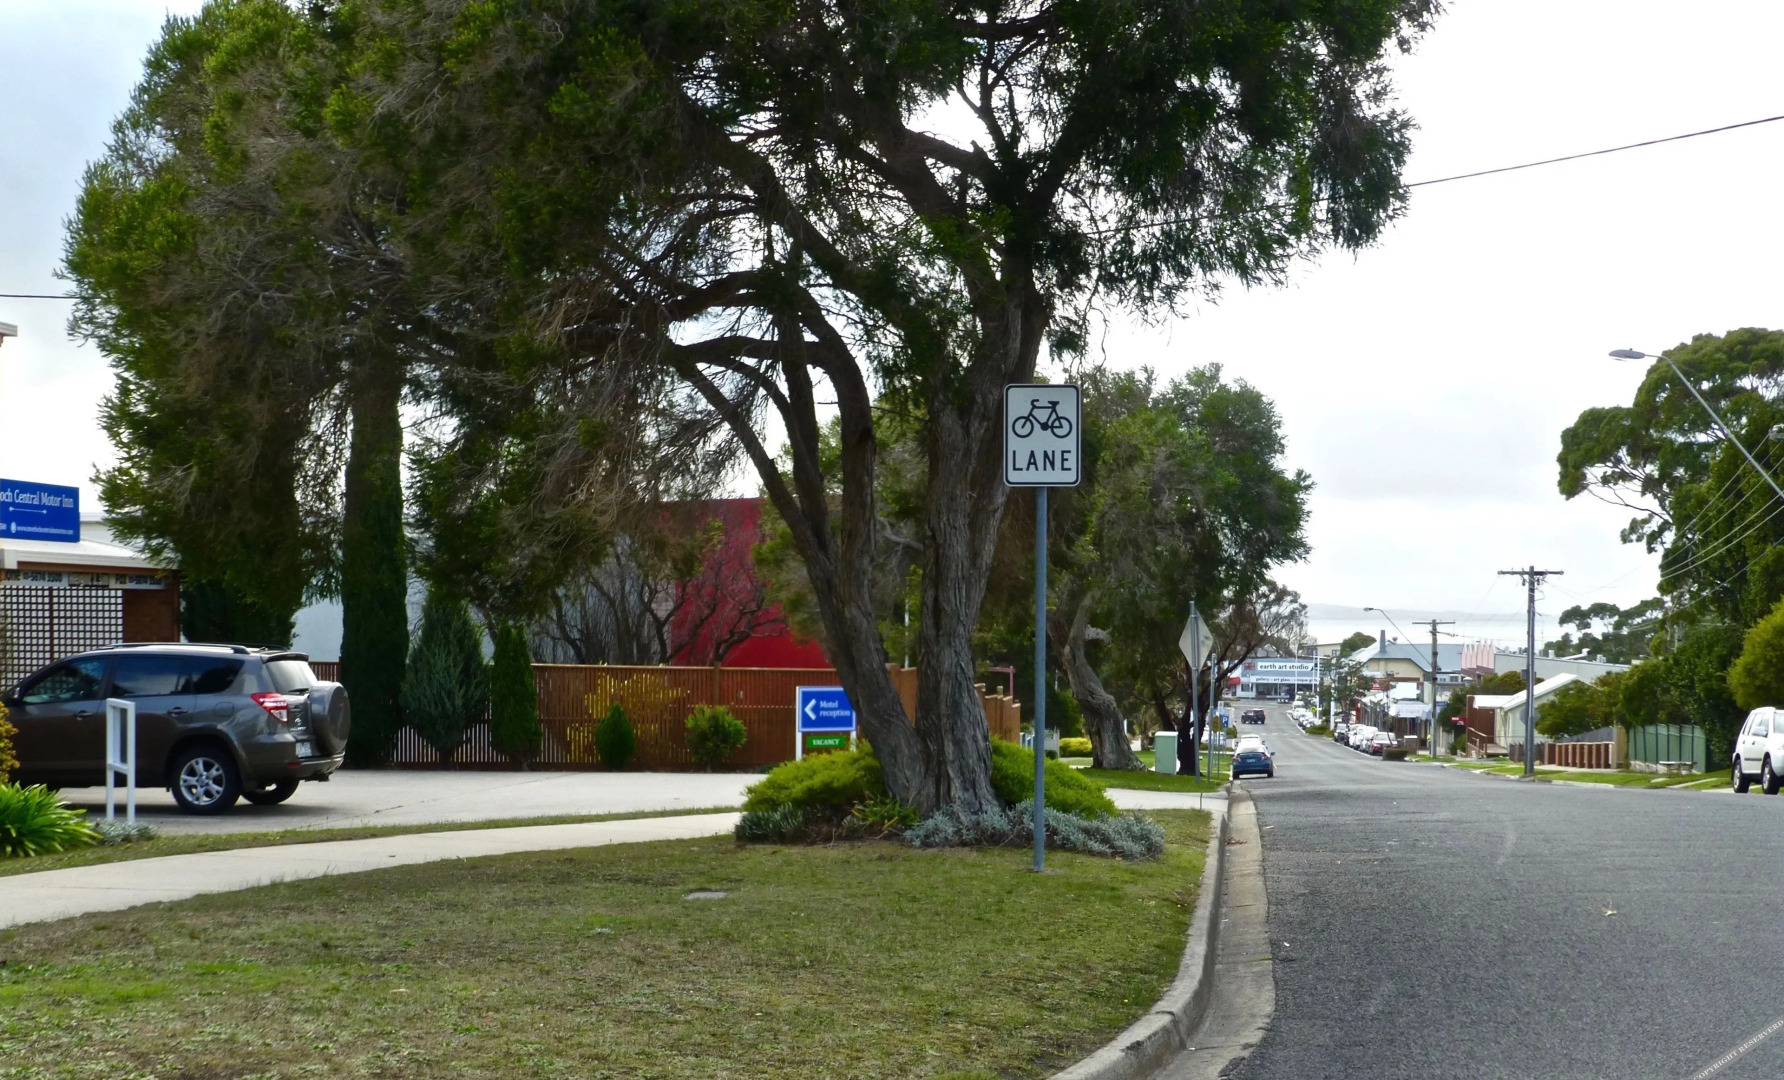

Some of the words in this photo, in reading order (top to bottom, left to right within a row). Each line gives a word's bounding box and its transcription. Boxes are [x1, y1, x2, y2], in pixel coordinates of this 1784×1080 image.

[1012, 449, 1072, 472] LANE
[14, 489, 40, 505] Central
[41, 492, 61, 507] Motor
[62, 494, 74, 508] Inn
[820, 700, 839, 708] Motel
[820, 710, 851, 718] reception
[812, 738, 840, 746] VACANCY
